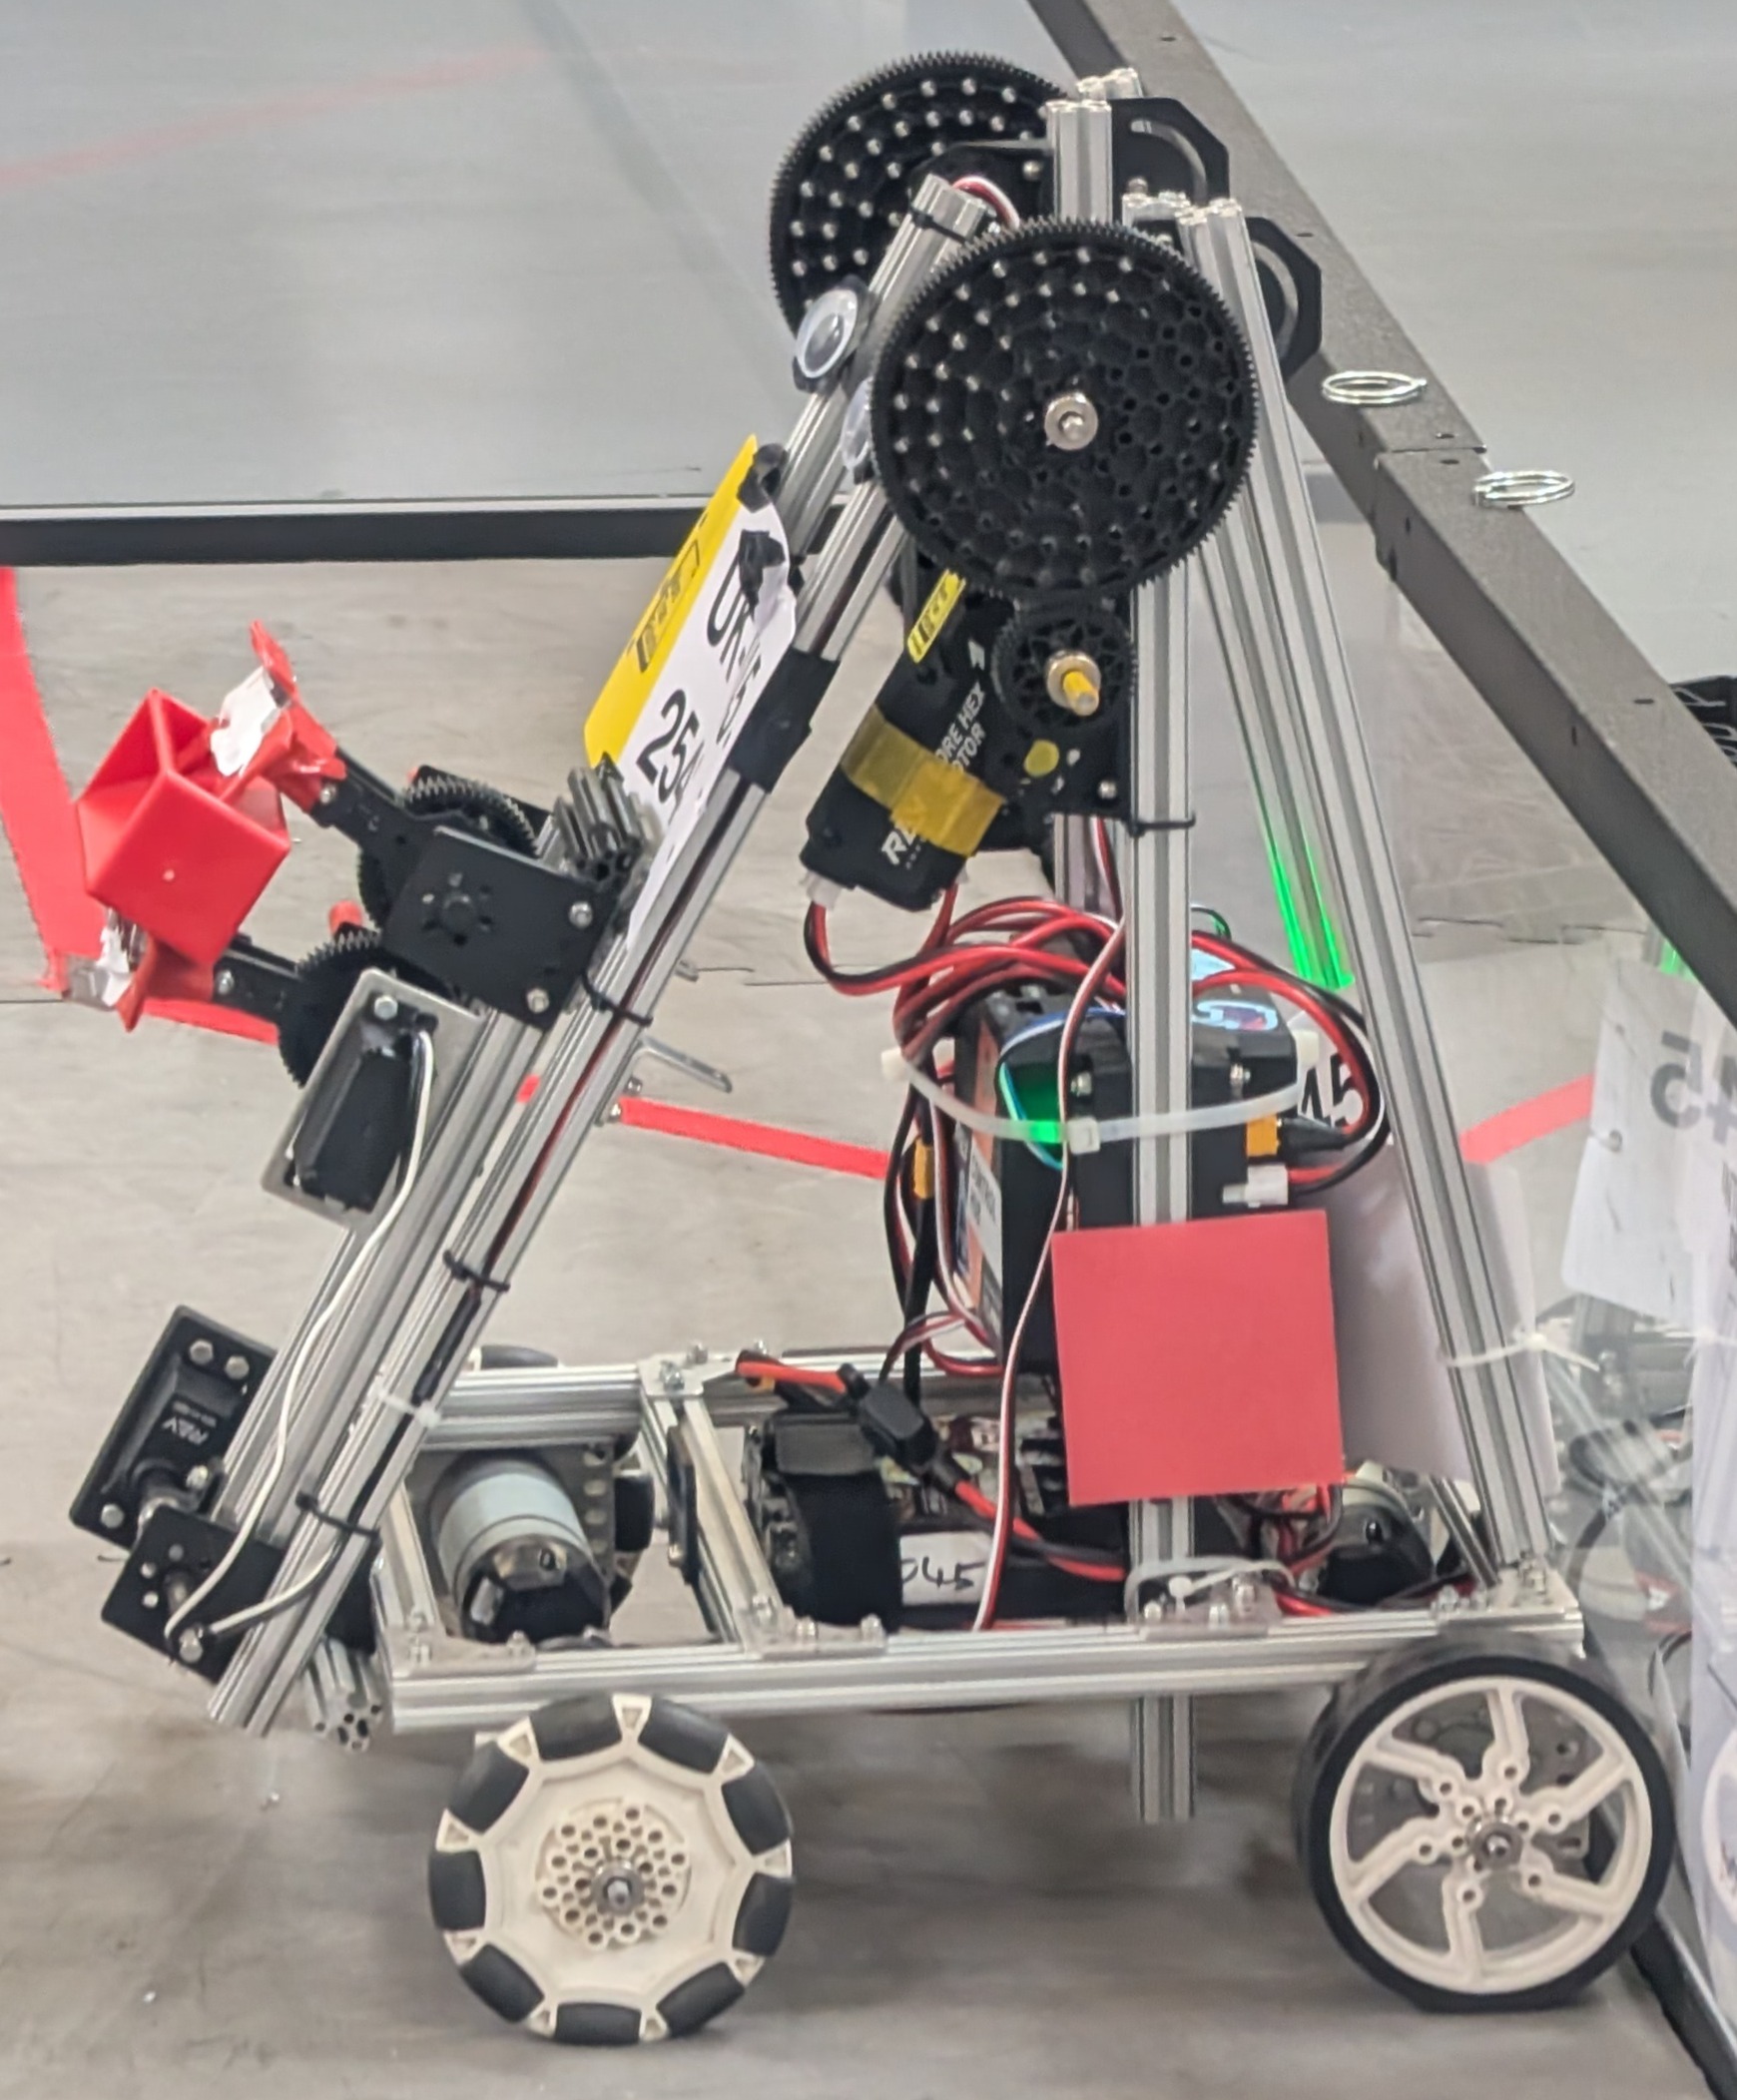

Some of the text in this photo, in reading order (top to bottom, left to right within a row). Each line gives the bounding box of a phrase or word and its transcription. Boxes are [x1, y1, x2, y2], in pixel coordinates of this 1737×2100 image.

[935, 681, 985, 764] ORE HEX
[951, 723, 986, 775] OTOR
